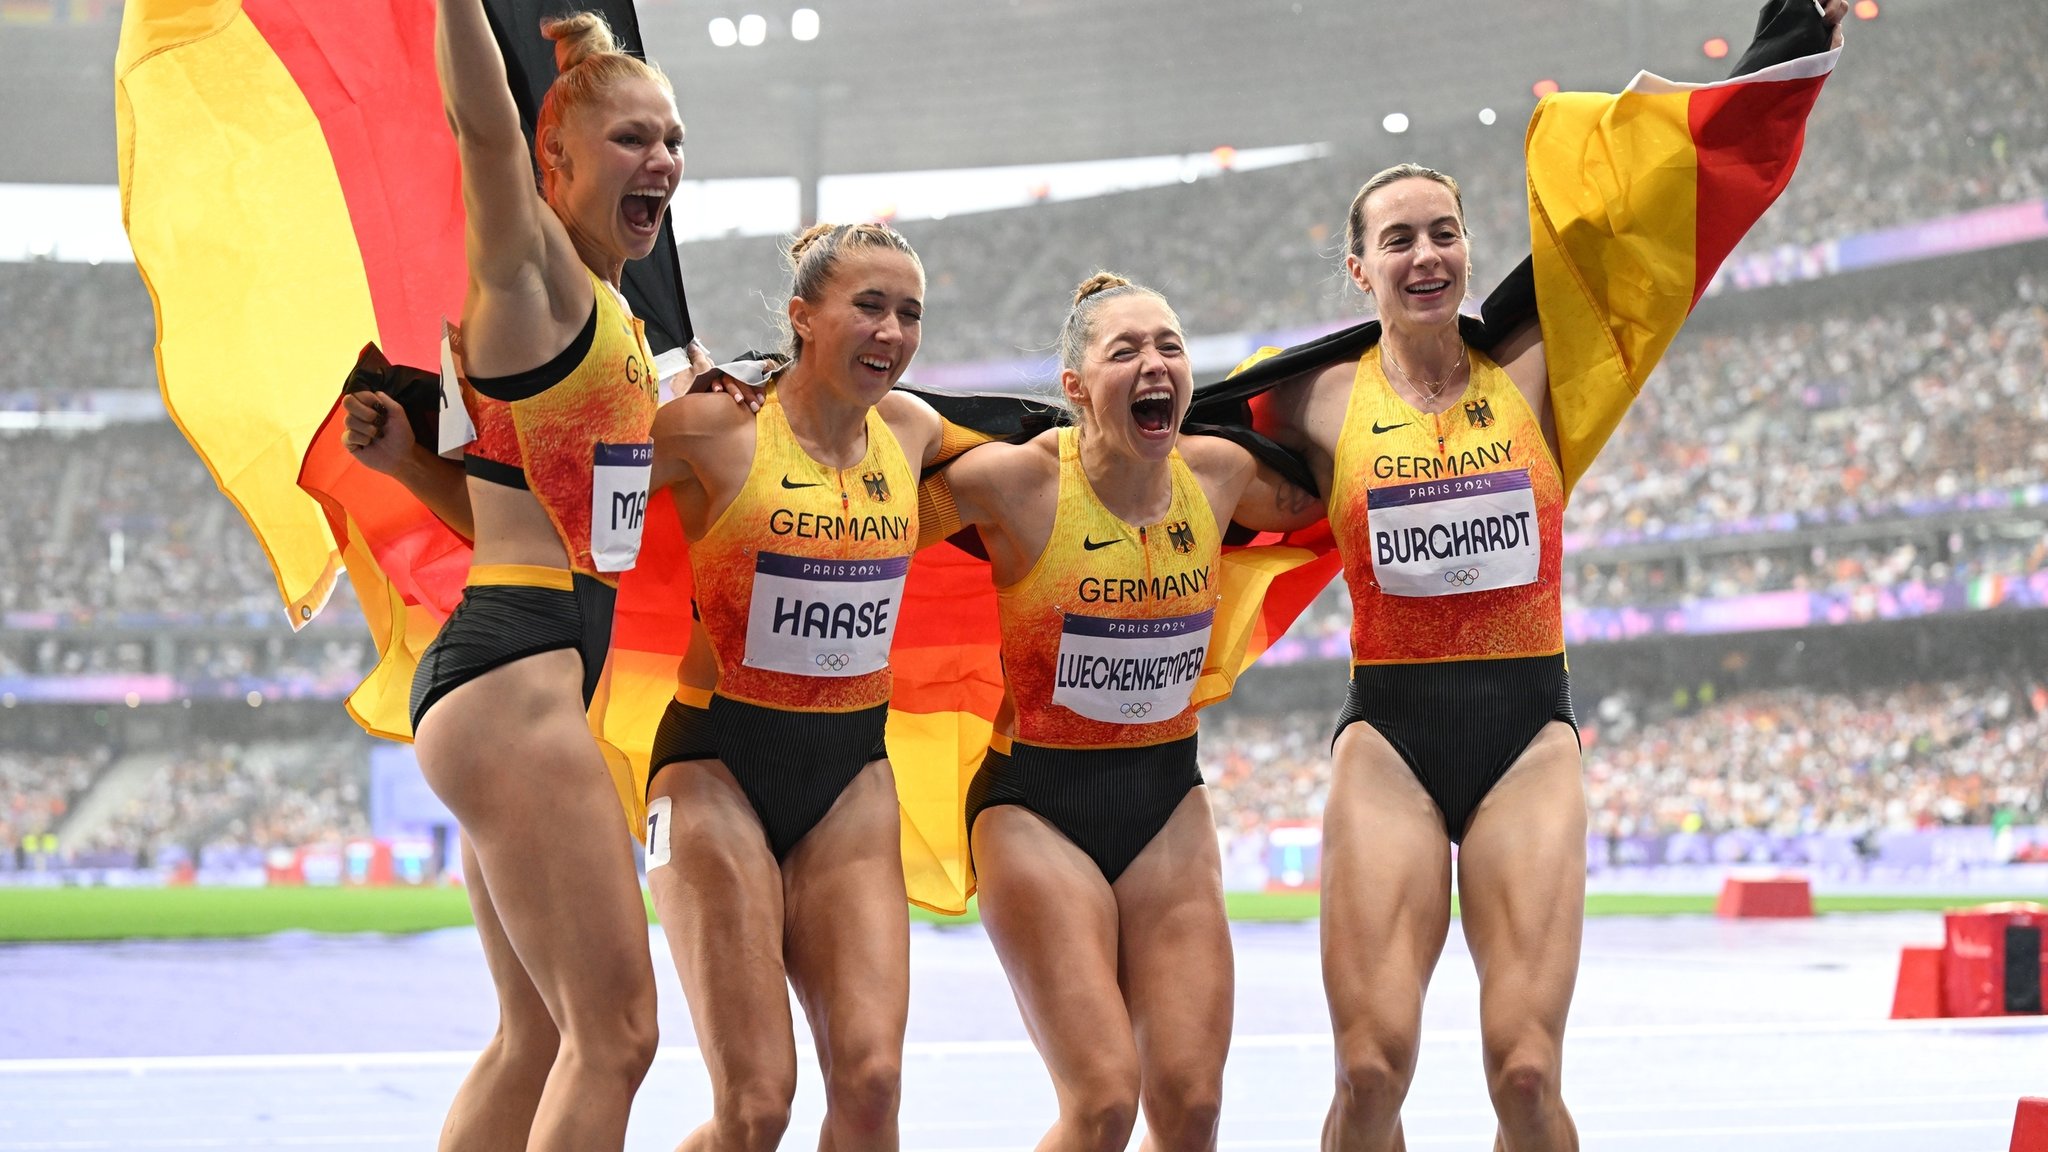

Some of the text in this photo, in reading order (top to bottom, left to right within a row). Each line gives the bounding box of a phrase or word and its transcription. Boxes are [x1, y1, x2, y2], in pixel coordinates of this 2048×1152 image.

[1373, 439, 1512, 479] GERMANY
[1408, 479, 1492, 499] PARIS 2024
[611, 490, 647, 531] MA
[769, 509, 909, 541] GERMANY
[1376, 511, 1530, 566] BURGHARDT
[803, 563, 882, 576] PARIS 2024
[1078, 565, 1209, 603] GERMANY
[772, 597, 891, 639] HAASE
[1108, 621, 1186, 634] PARIS 2024
[1057, 646, 1205, 692] LUECKENKEMPER
